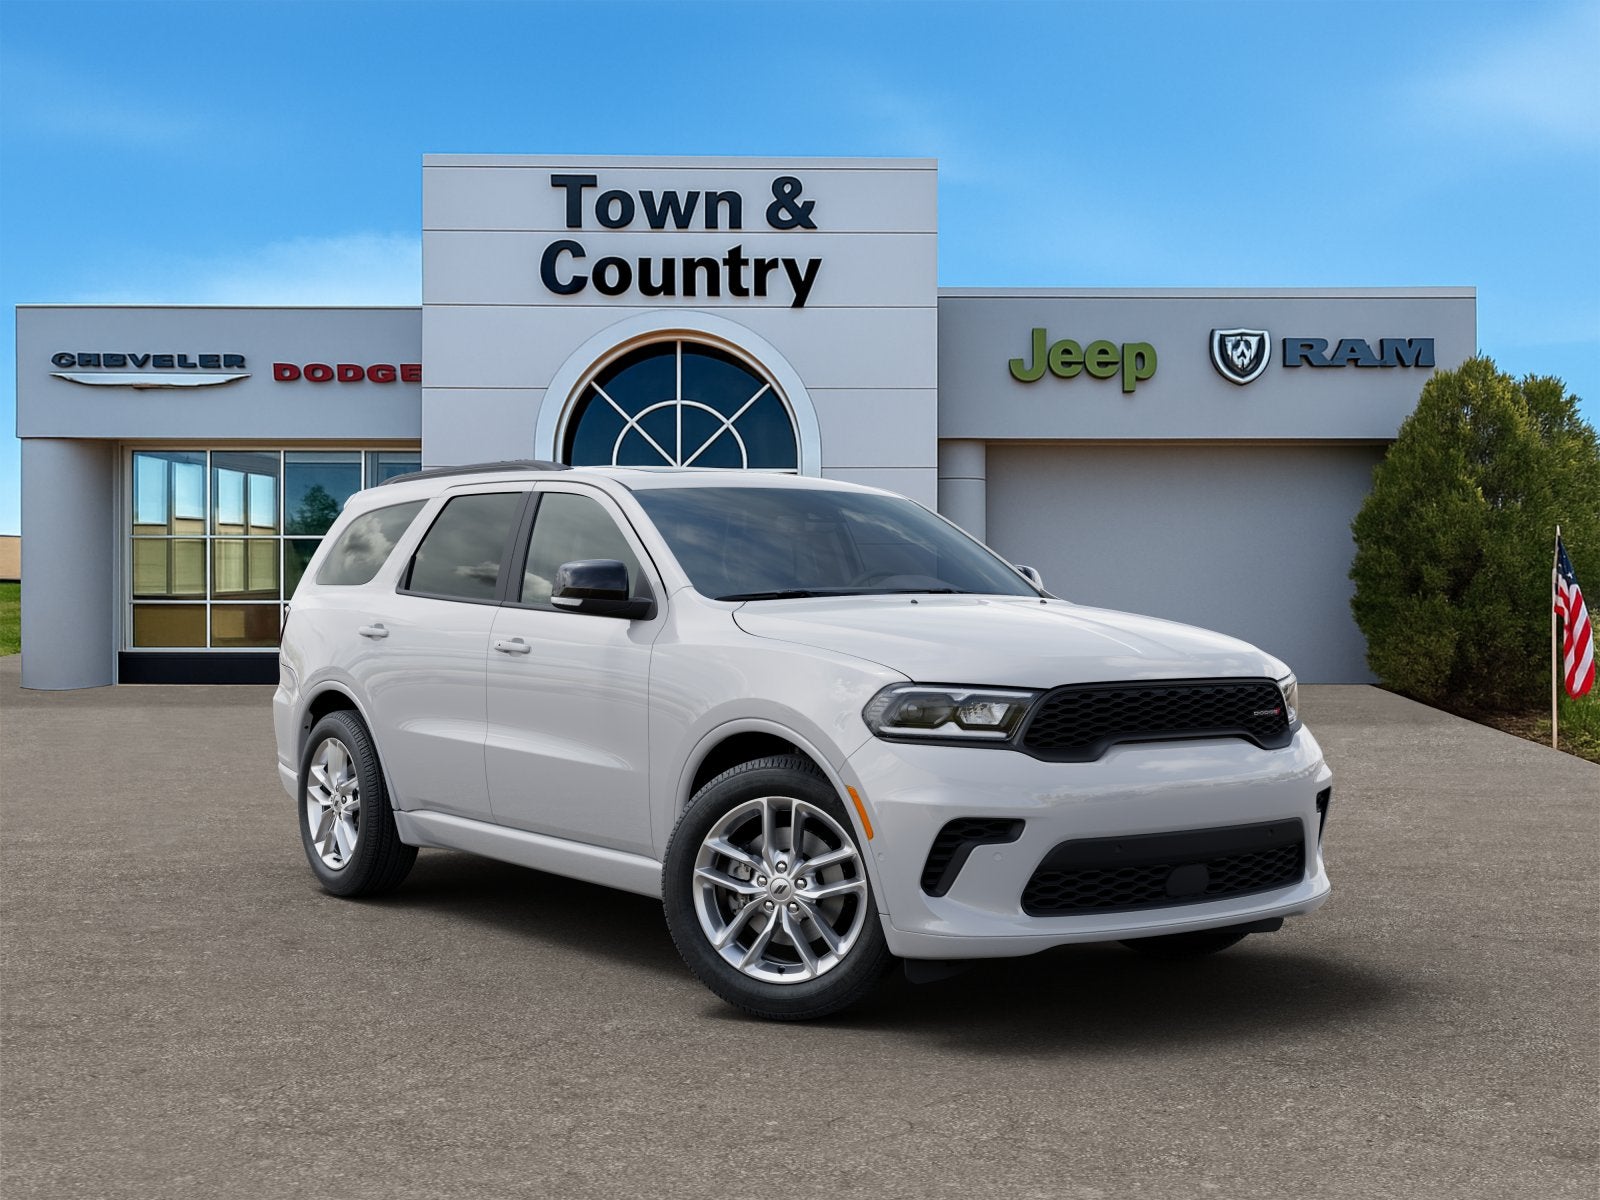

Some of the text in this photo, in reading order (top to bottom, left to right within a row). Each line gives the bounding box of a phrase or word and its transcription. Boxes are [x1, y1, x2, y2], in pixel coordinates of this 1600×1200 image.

[550, 174, 818, 231] Town &
[539, 239, 823, 308] Country
[273, 362, 421, 384] DODGE
[1009, 328, 1157, 393] Jeep
[1282, 337, 1436, 368] RAM
